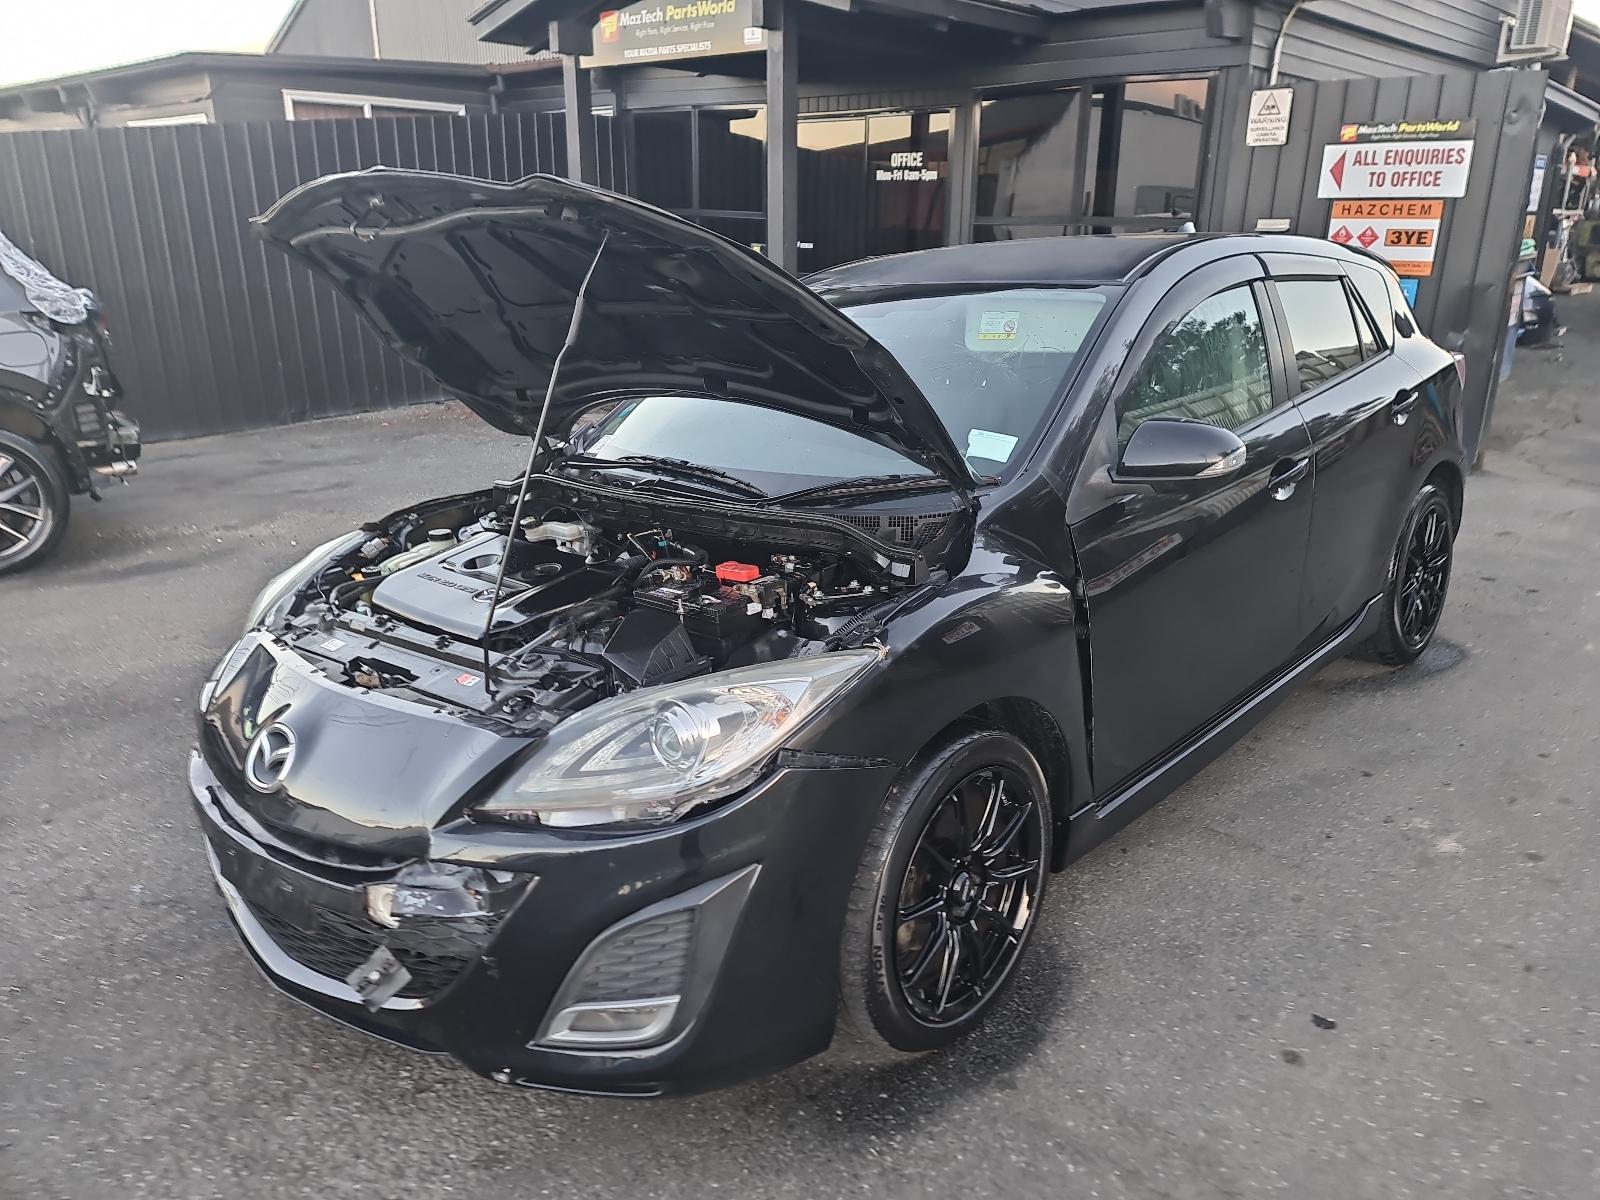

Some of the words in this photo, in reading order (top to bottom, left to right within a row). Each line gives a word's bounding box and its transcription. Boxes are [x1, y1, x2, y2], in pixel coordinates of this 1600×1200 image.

[620, 7, 664, 26] MazTech
[666, 0, 736, 20] PartsWorld
[624, 48, 639, 58] YOUR
[639, 47, 658, 57] MAZDA
[658, 45, 676, 55] PARTS
[676, 41, 712, 53] SPECIALISTS
[1250, 116, 1288, 124] WARNING
[1358, 123, 1398, 134] MazTech
[1398, 119, 1461, 133] PartsWorld
[890, 152, 924, 167] OFFICE
[1352, 149, 1379, 166] ALL
[1383, 147, 1466, 166] ENQUIRIES
[1368, 171, 1386, 187] TO
[1390, 170, 1443, 187] OFFICE
[1341, 203, 1433, 216] HAZCHEM
[1390, 230, 1429, 245] 3YE
